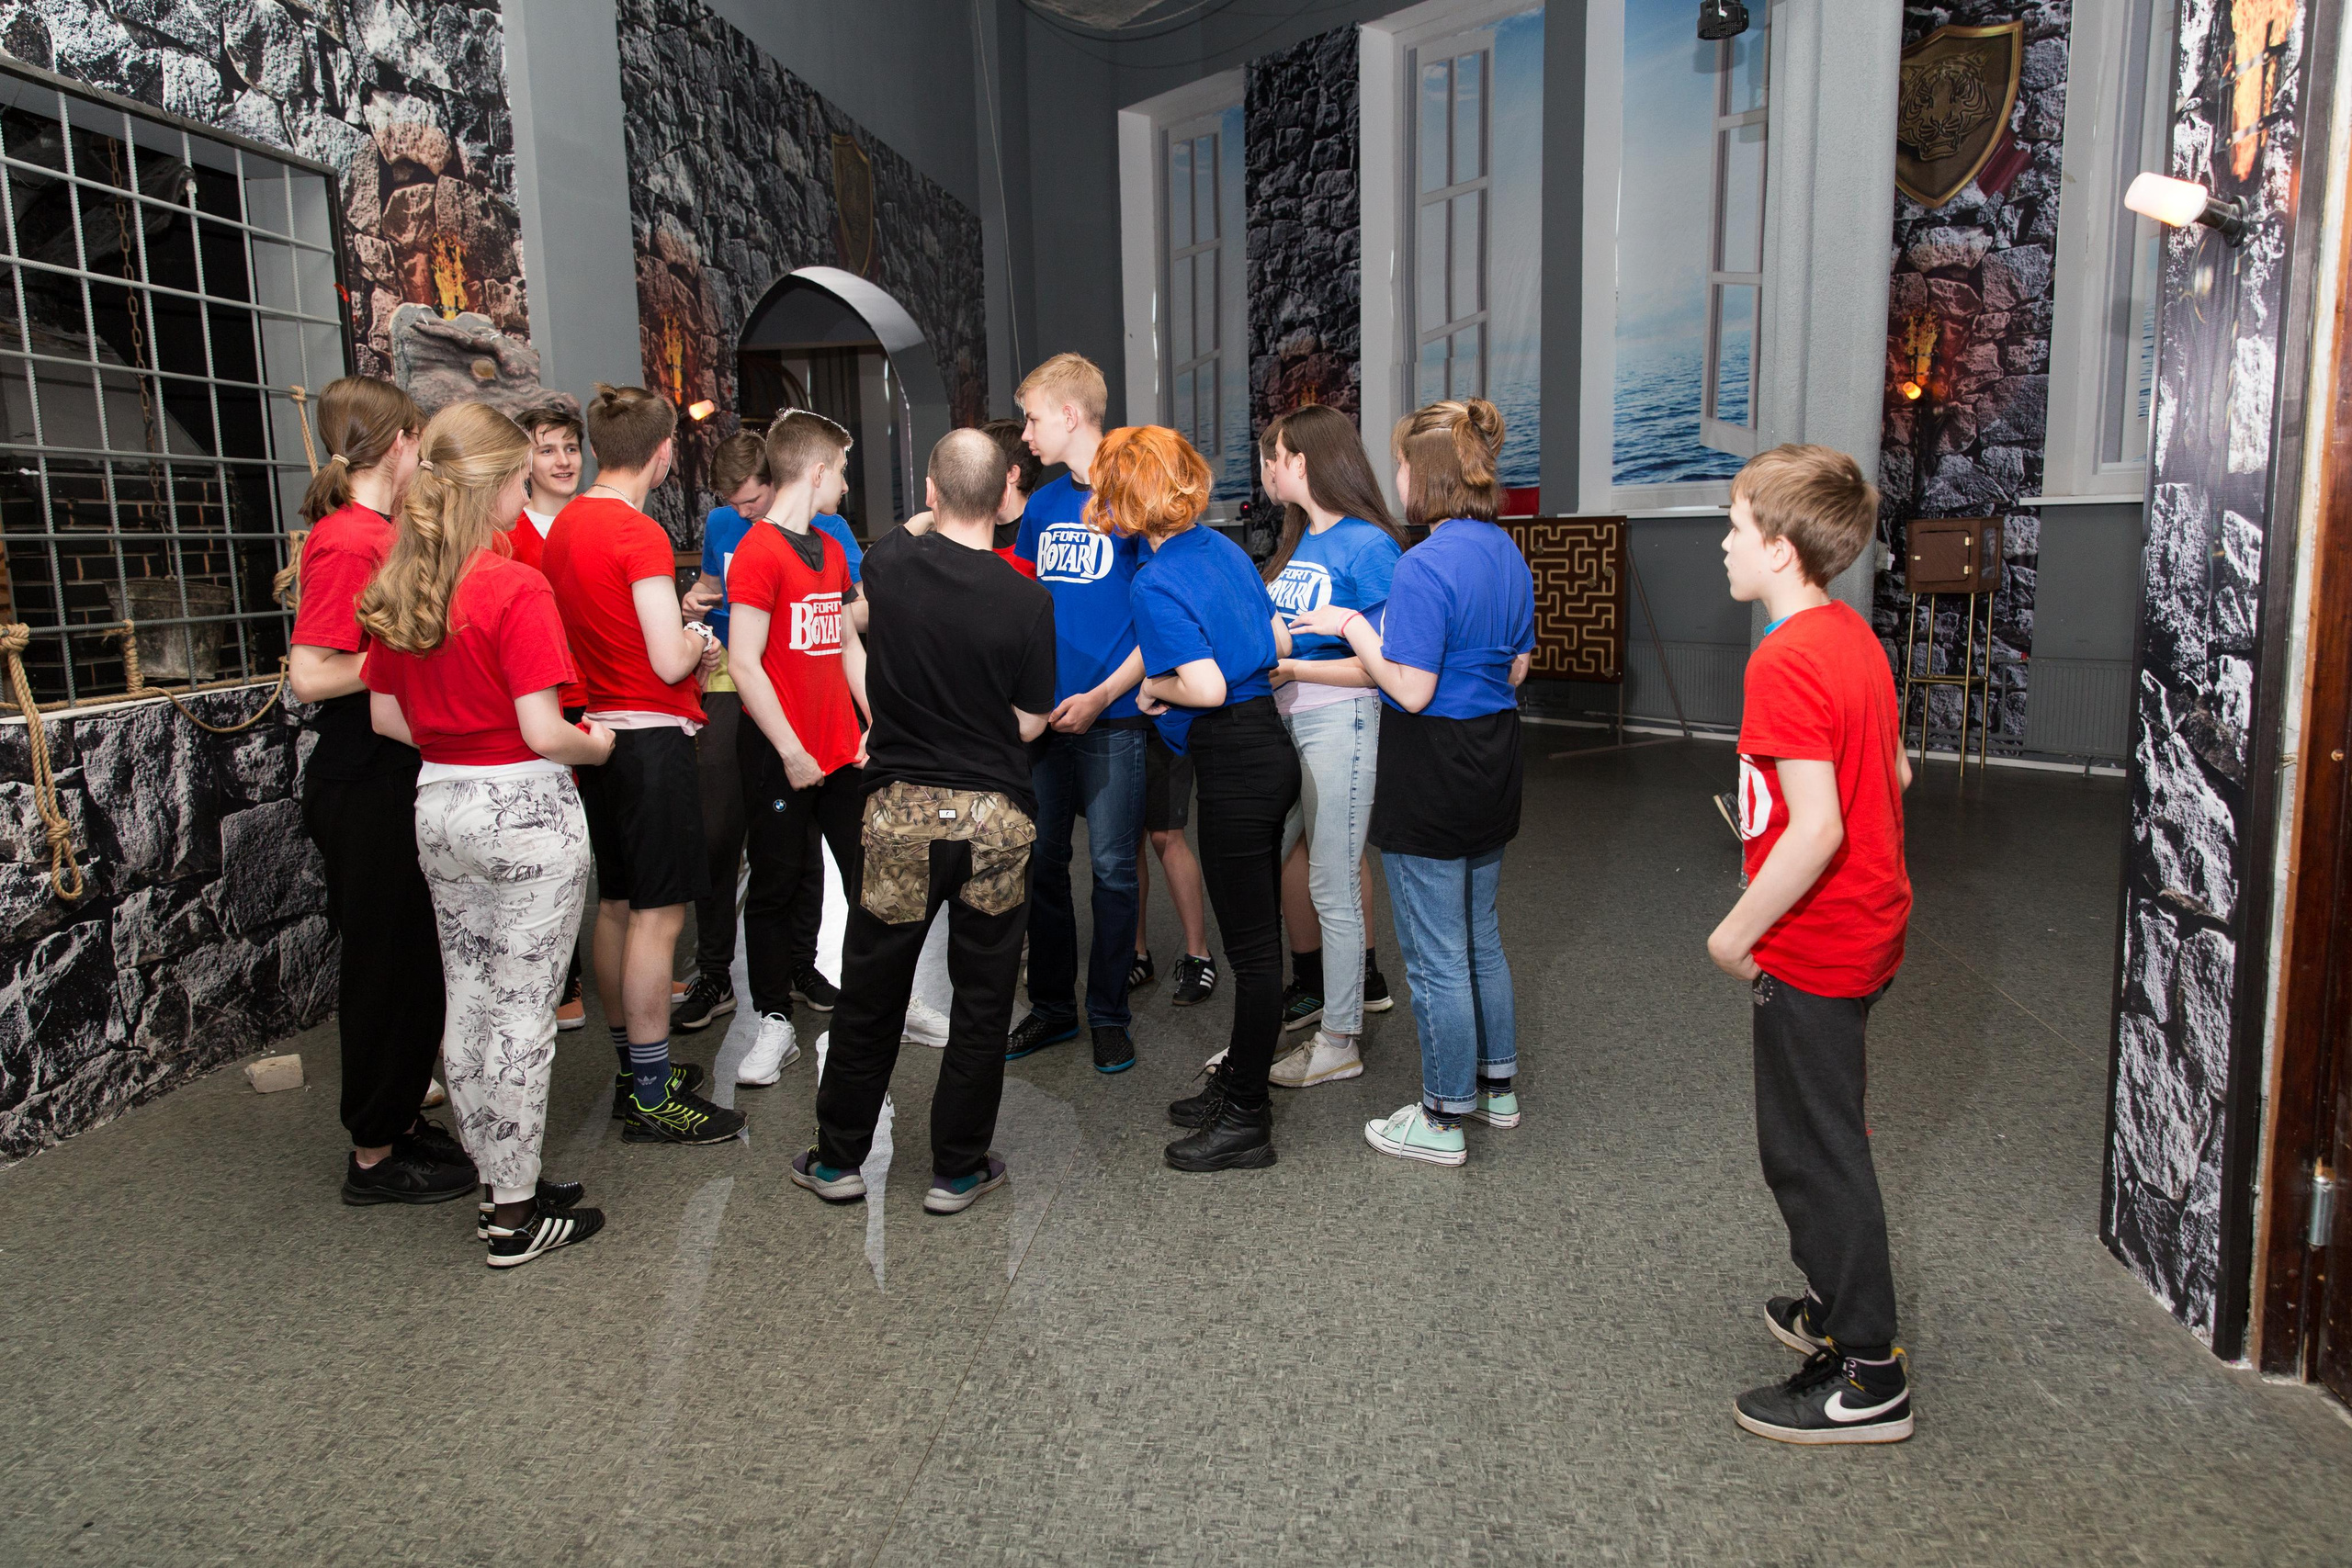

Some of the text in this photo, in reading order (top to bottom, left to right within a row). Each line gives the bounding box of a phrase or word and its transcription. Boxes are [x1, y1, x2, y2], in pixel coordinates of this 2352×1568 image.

[1052, 531, 1089, 543] FORT
[1036, 531, 1114, 581] BOYARD
[1281, 568, 1311, 581] FORT
[1266, 570, 1332, 615] OYARD
[813, 601, 840, 614] FORT
